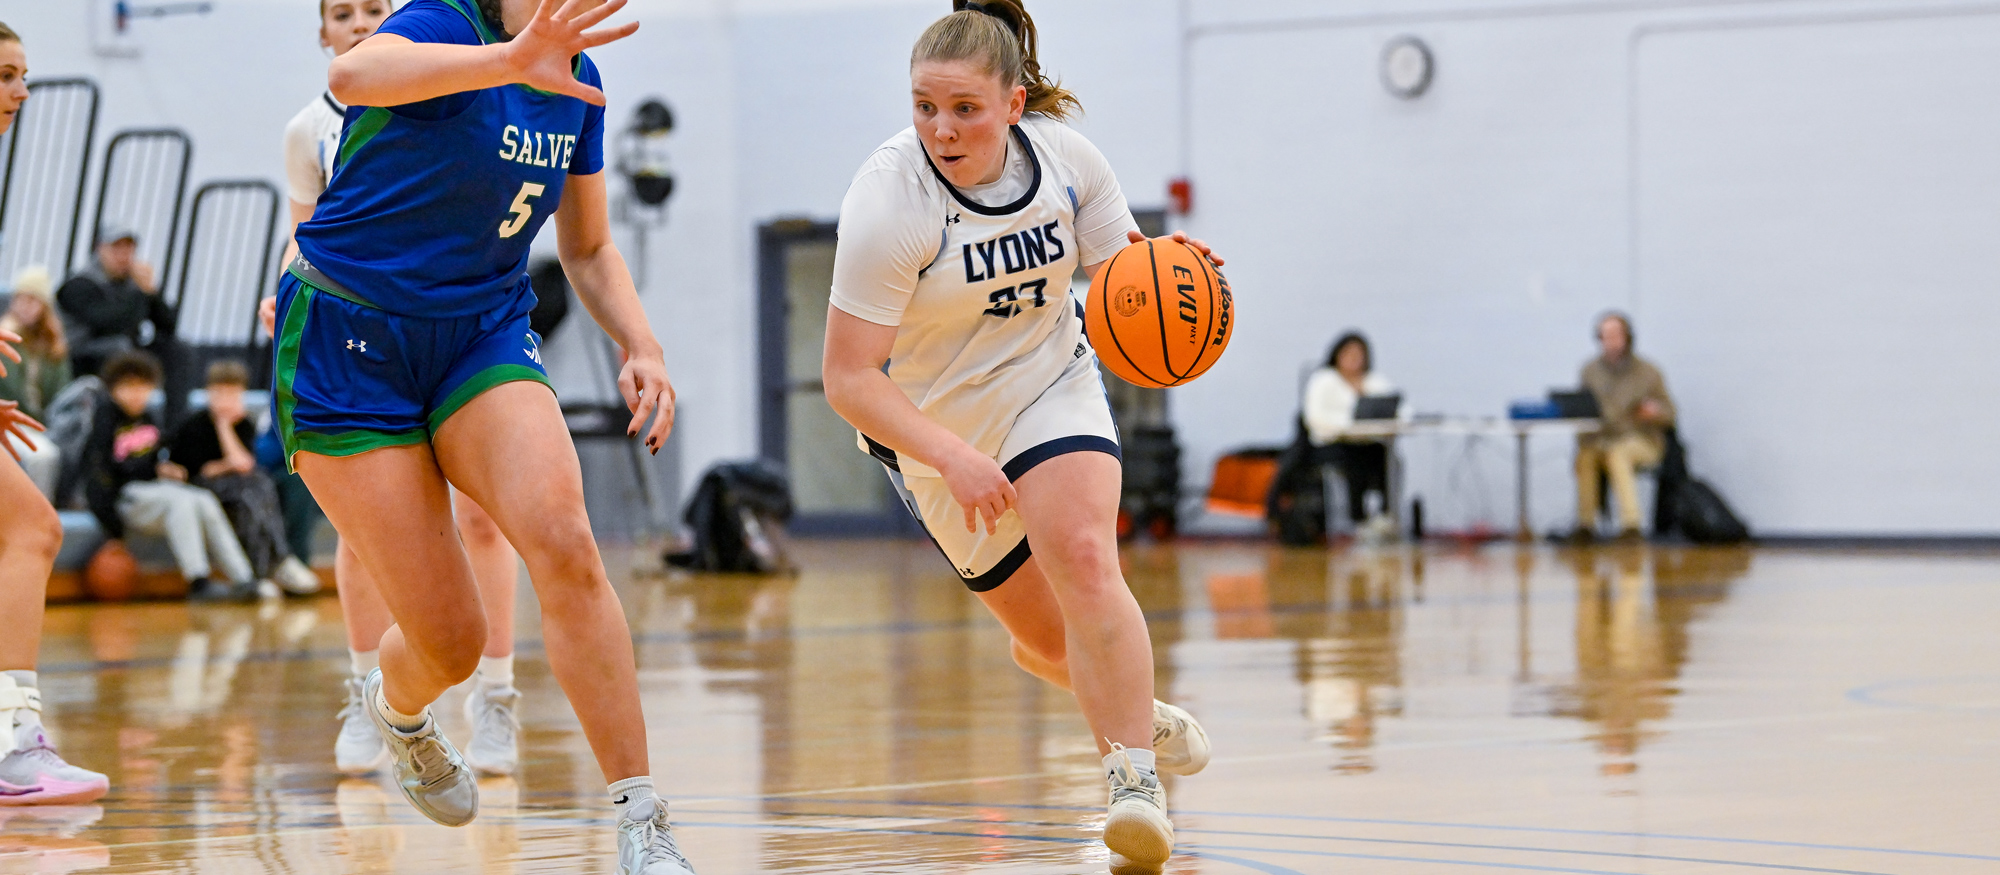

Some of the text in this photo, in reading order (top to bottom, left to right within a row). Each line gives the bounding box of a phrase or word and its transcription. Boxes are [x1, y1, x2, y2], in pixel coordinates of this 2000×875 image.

[498, 124, 576, 169] SALVE
[498, 181, 546, 238] 5
[962, 218, 1065, 284] LYONS
[982, 277, 1048, 318] 27
[1173, 265, 1197, 346] EVO NXT
